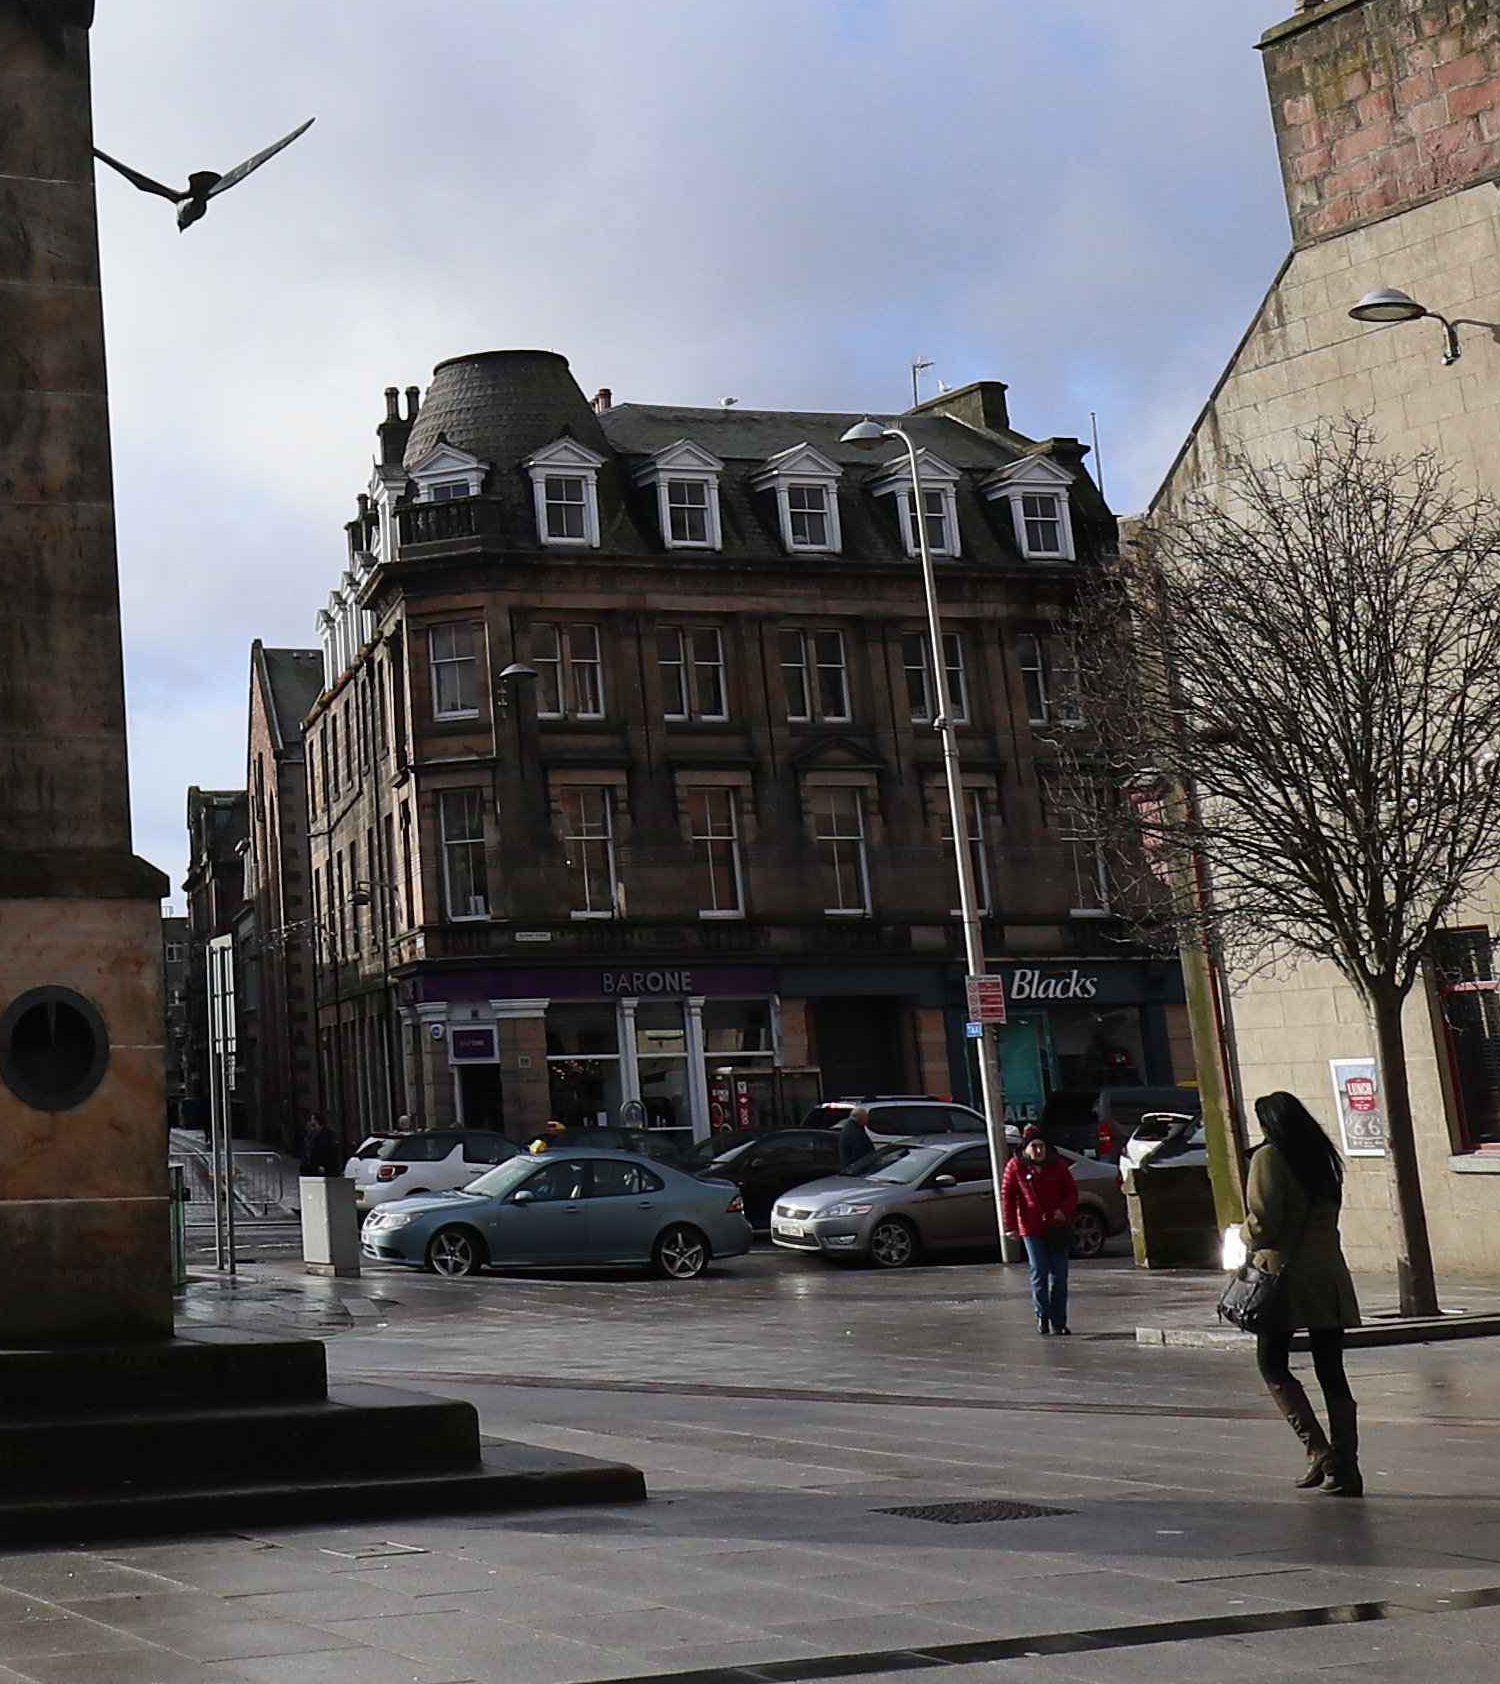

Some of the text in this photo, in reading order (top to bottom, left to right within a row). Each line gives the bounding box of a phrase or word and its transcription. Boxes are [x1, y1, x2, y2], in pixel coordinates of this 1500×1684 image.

[1010, 968, 1098, 1001] Blacks
[1346, 1082, 1373, 1096] LUNCH
[1004, 1105, 1038, 1122] ALE
